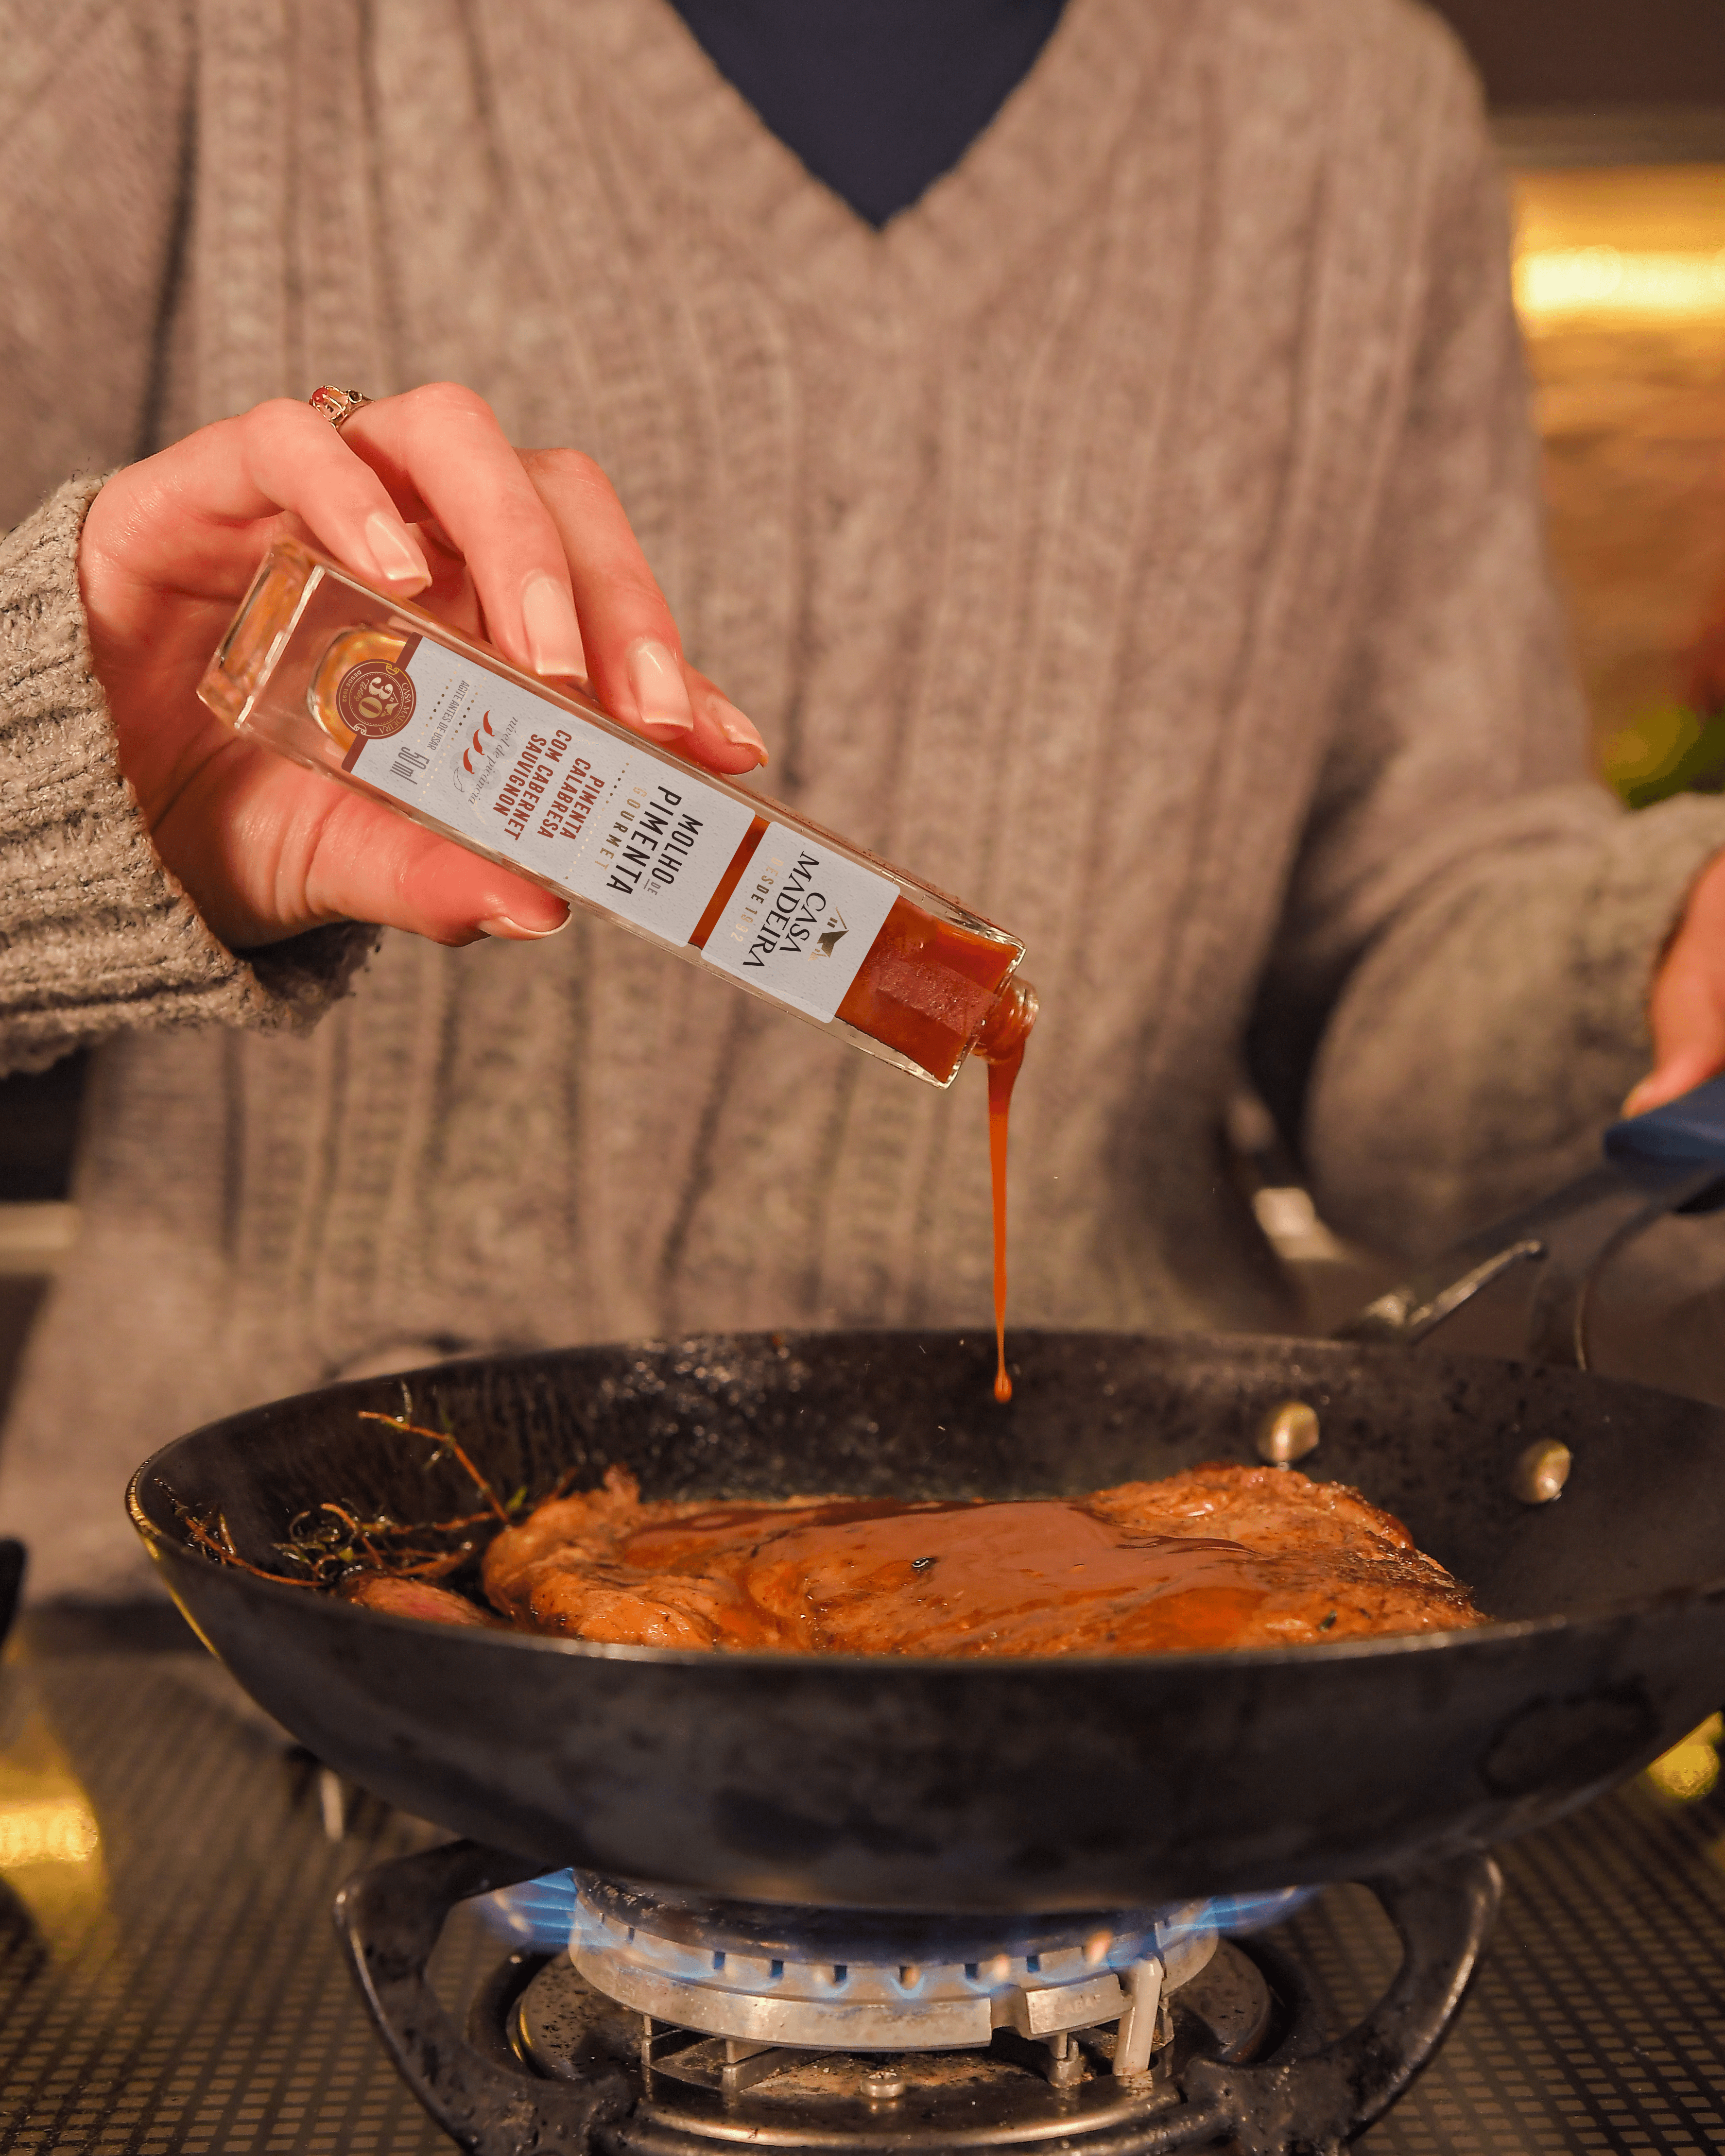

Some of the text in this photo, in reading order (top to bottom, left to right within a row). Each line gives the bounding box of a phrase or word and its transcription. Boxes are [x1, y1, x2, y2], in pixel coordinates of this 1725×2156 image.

[345, 670, 362, 687] DESDE
[359, 677, 393, 718] 30
[379, 683, 411, 734] CASA MADEIRA
[427, 680, 469, 750] AGITE ANTES DE USAR
[390, 746, 430, 785] 50 ml
[468, 717, 518, 804] nível de picância
[493, 734, 547, 816] SAUVIGNON
[504, 729, 571, 840] COM CABERNET
[537, 758, 591, 838] CALABRESA
[559, 775, 604, 839] PIMENTA
[594, 786, 647, 871] GOURMET
[606, 786, 682, 894] PIMENTA
[647, 813, 703, 895] MOLHO DE
[730, 856, 784, 941] DESDE 1992
[742, 851, 819, 966] MADEIRA
[779, 892, 826, 952] CASA
[1055, 1994, 1102, 2015] ABAF
